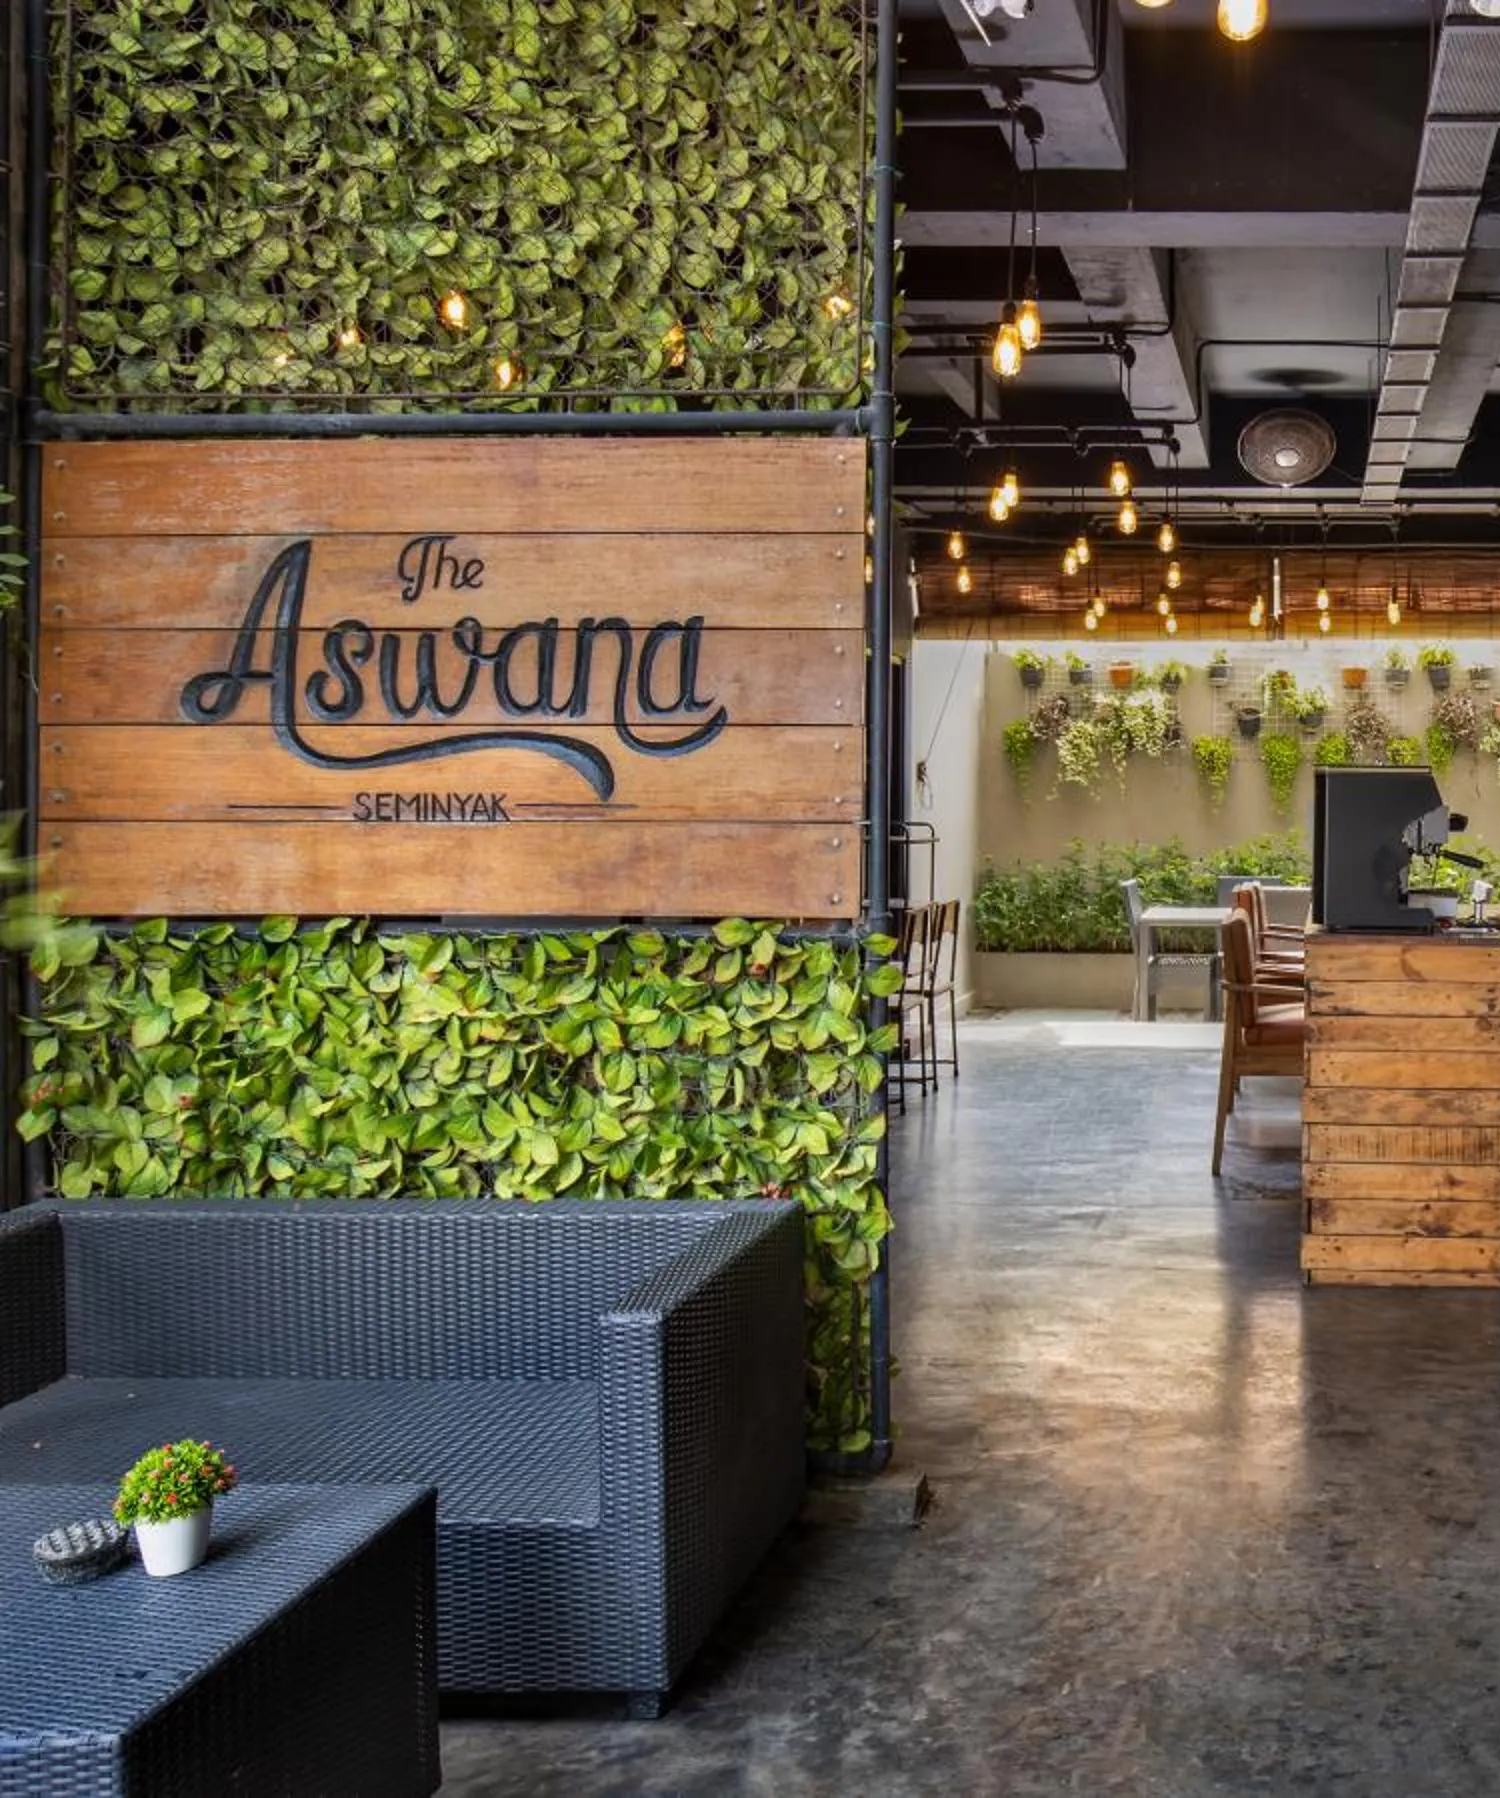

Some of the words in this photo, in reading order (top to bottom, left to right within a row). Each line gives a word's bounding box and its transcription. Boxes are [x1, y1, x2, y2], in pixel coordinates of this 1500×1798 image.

[398, 535, 485, 602] The
[180, 539, 727, 801] Aswana
[352, 792, 511, 822] SEMINYAK
